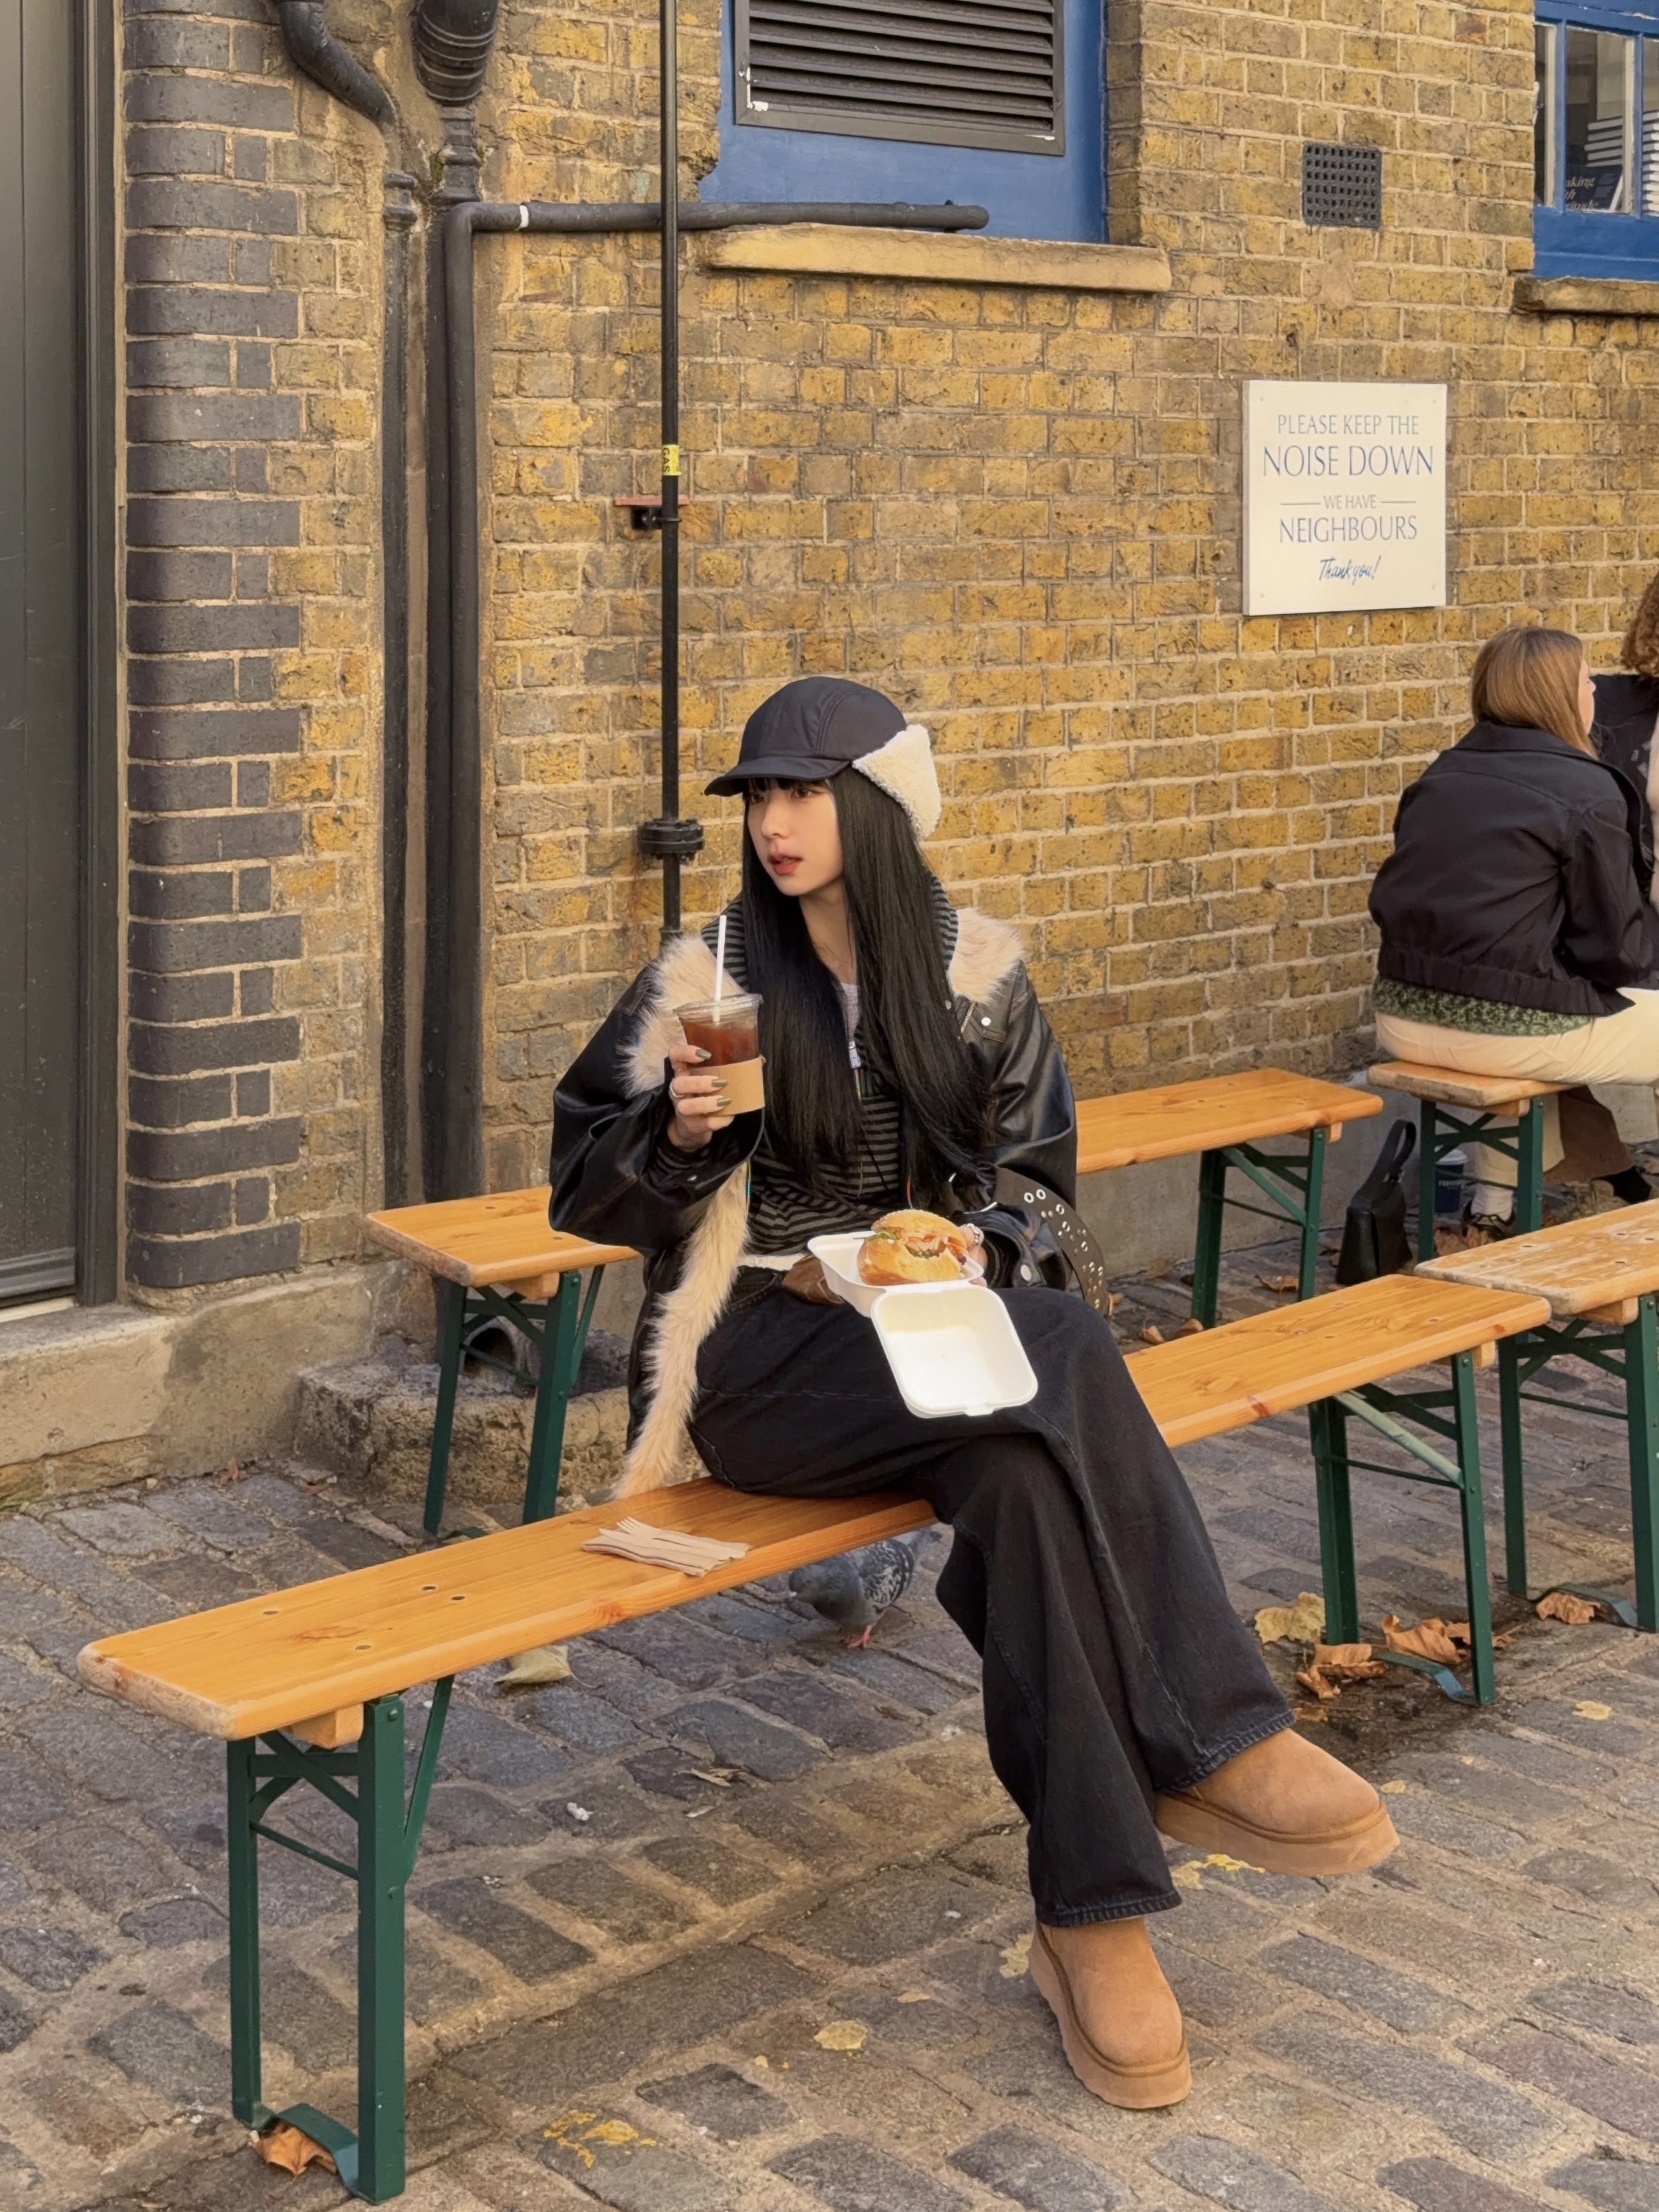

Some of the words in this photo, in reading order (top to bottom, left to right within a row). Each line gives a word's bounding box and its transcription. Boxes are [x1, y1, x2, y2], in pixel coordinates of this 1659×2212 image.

[1278, 414, 1338, 434] PLEASE
[1343, 414, 1382, 435] KEEP
[1387, 415, 1420, 435] THE
[662, 447, 671, 473] GAS
[1263, 445, 1339, 477] NOISE
[1349, 445, 1433, 476] DOWN
[1323, 495, 1342, 509] WE
[1345, 493, 1377, 509] HAVE
[1280, 515, 1417, 543] NEIGHBOURS
[1318, 556, 1351, 581] Thank
[1351, 554, 1382, 586] you!
